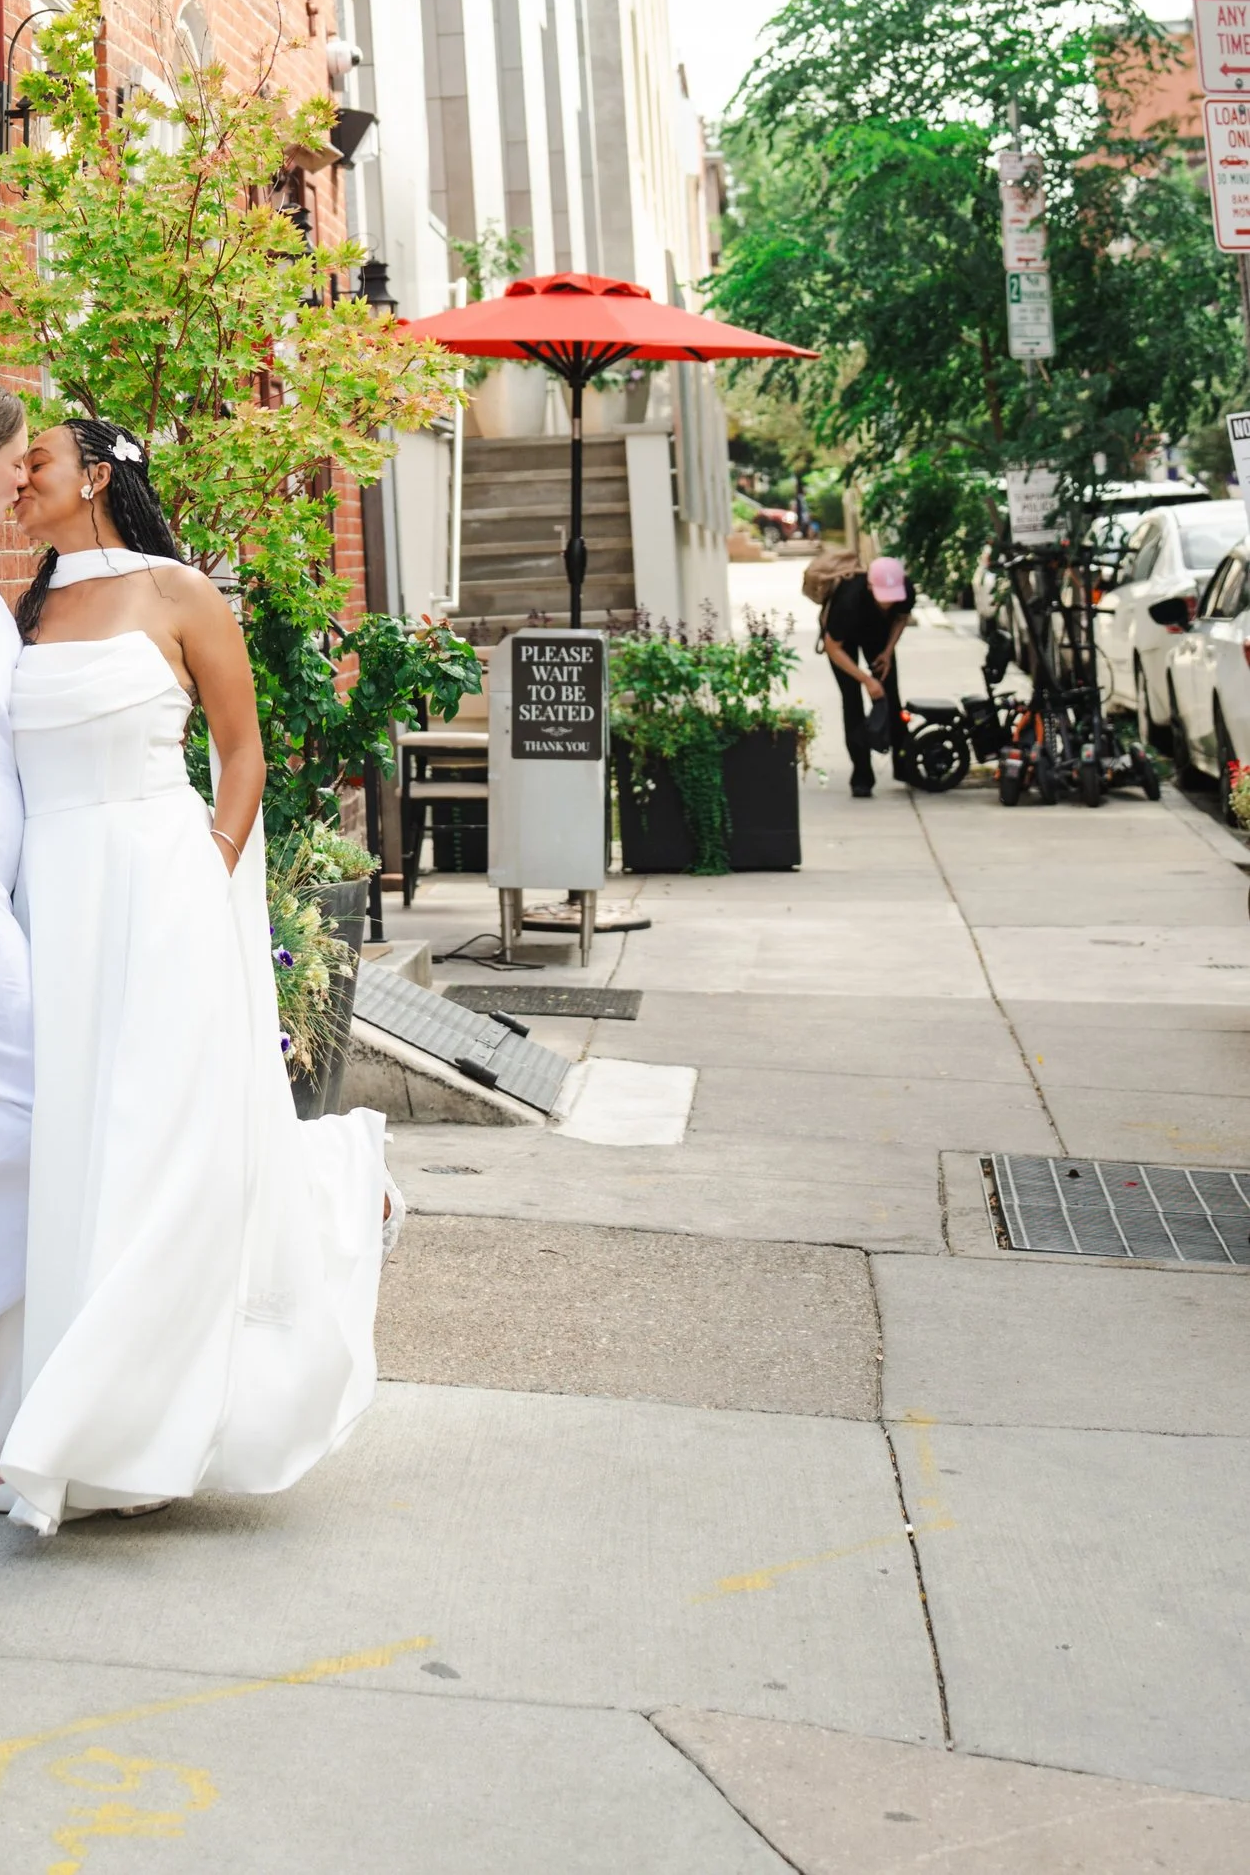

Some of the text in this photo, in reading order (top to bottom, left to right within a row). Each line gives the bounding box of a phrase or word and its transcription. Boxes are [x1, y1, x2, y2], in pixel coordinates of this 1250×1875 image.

[1218, 6, 1247, 27] ANY
[1216, 33, 1250, 55] TIME
[520, 645, 594, 663] PLEASE
[532, 665, 582, 682] WAIT
[527, 685, 586, 702] TO BE
[519, 704, 595, 722] SEATED
[523, 740, 590, 752] THANK YOU
